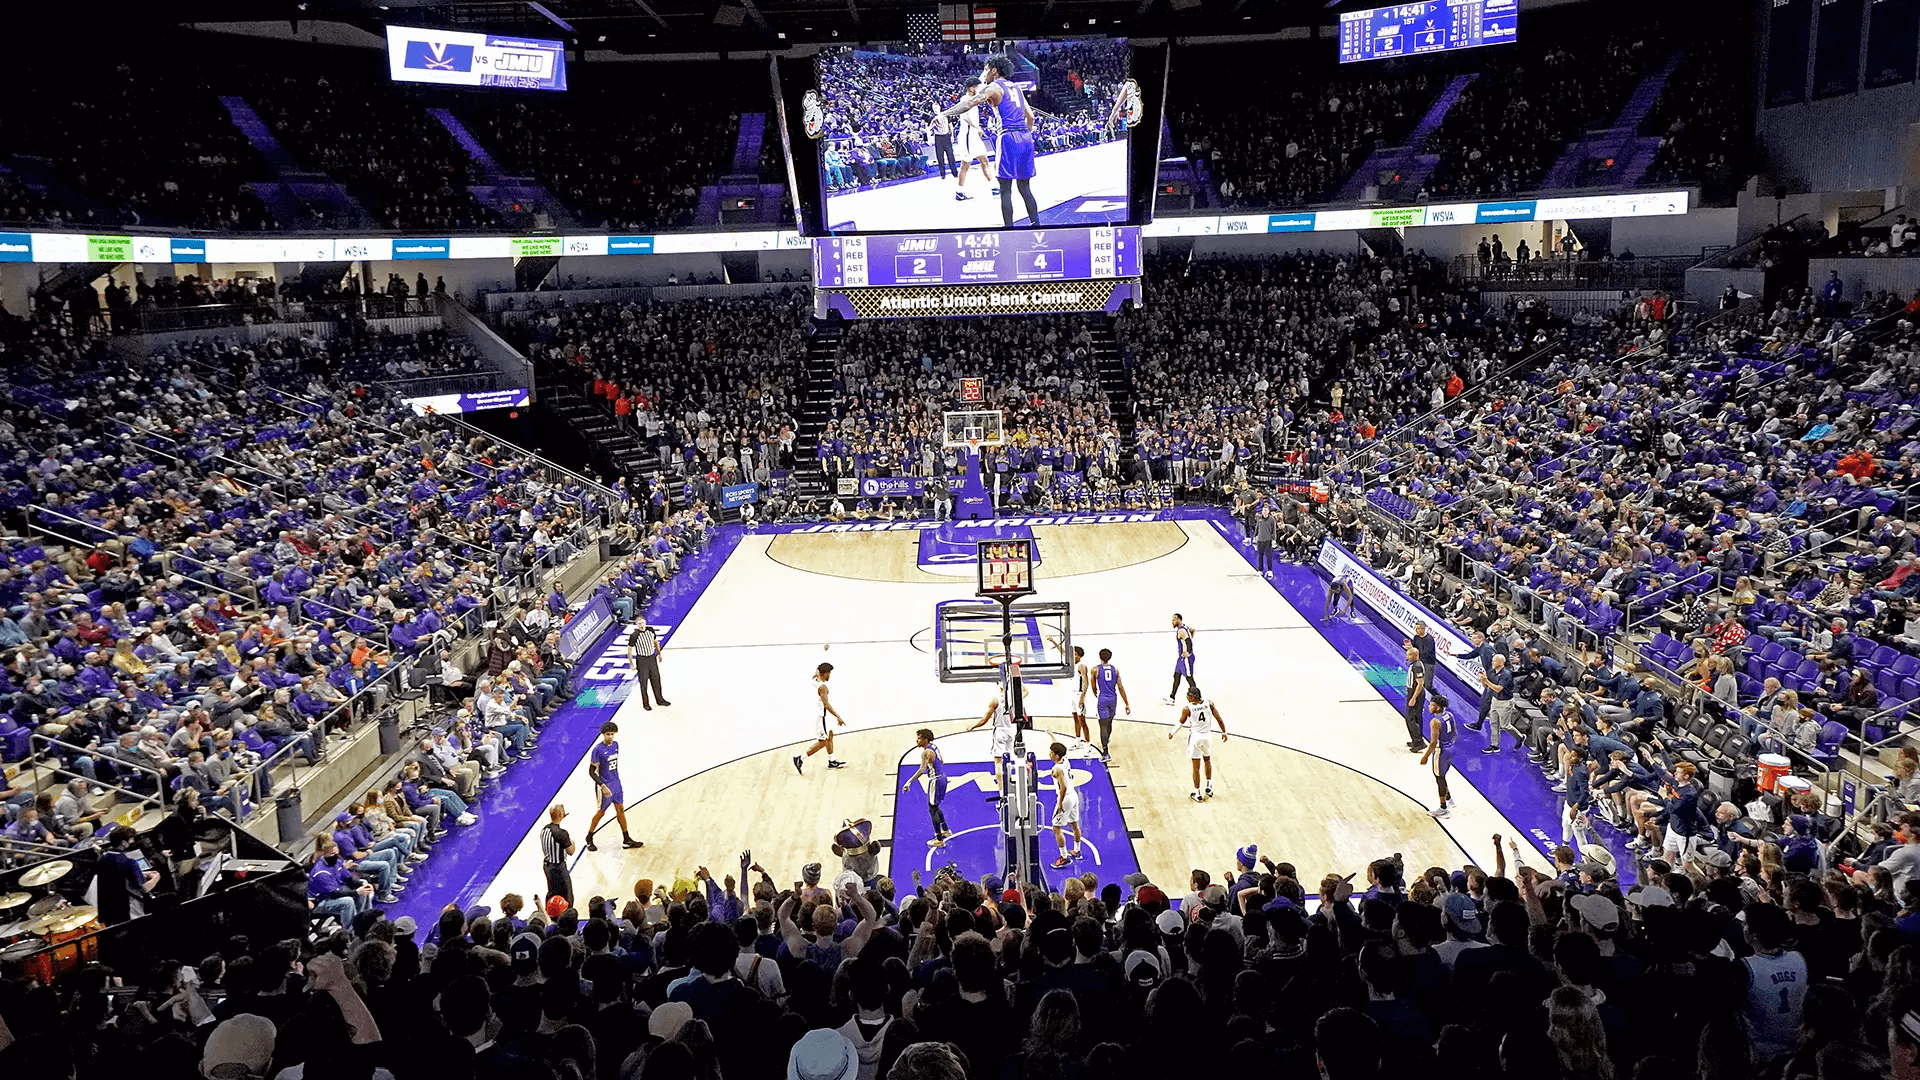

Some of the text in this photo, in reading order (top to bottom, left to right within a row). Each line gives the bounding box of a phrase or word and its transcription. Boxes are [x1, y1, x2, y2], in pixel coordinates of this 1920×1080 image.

[1392, 4, 1424, 18] 14:41
[1384, 38, 1393, 50] 2
[1425, 33, 1435, 44] 4
[494, 52, 544, 72] JMU
[1432, 212, 1454, 222] WSVA
[1227, 222, 1248, 231] WSVA
[786, 237, 808, 246] WSVA
[897, 237, 938, 252] JMU
[955, 234, 1000, 248] 14:41
[970, 248, 989, 258] 1ST
[913, 258, 926, 274] 2
[1034, 254, 1047, 269] 4
[880, 290, 1082, 310] Atlantic Union Bank Center
[965, 388, 980, 400] 22
[791, 514, 1156, 534] JAMES MADISON
[1342, 563, 1360, 584] WHERE
[1358, 576, 1390, 607] CUSTOMERS
[1387, 599, 1404, 618] SEND
[1104, 670, 1112, 682] 0
[1198, 712, 1206, 722] 4
[1778, 987, 1790, 1014] 1
